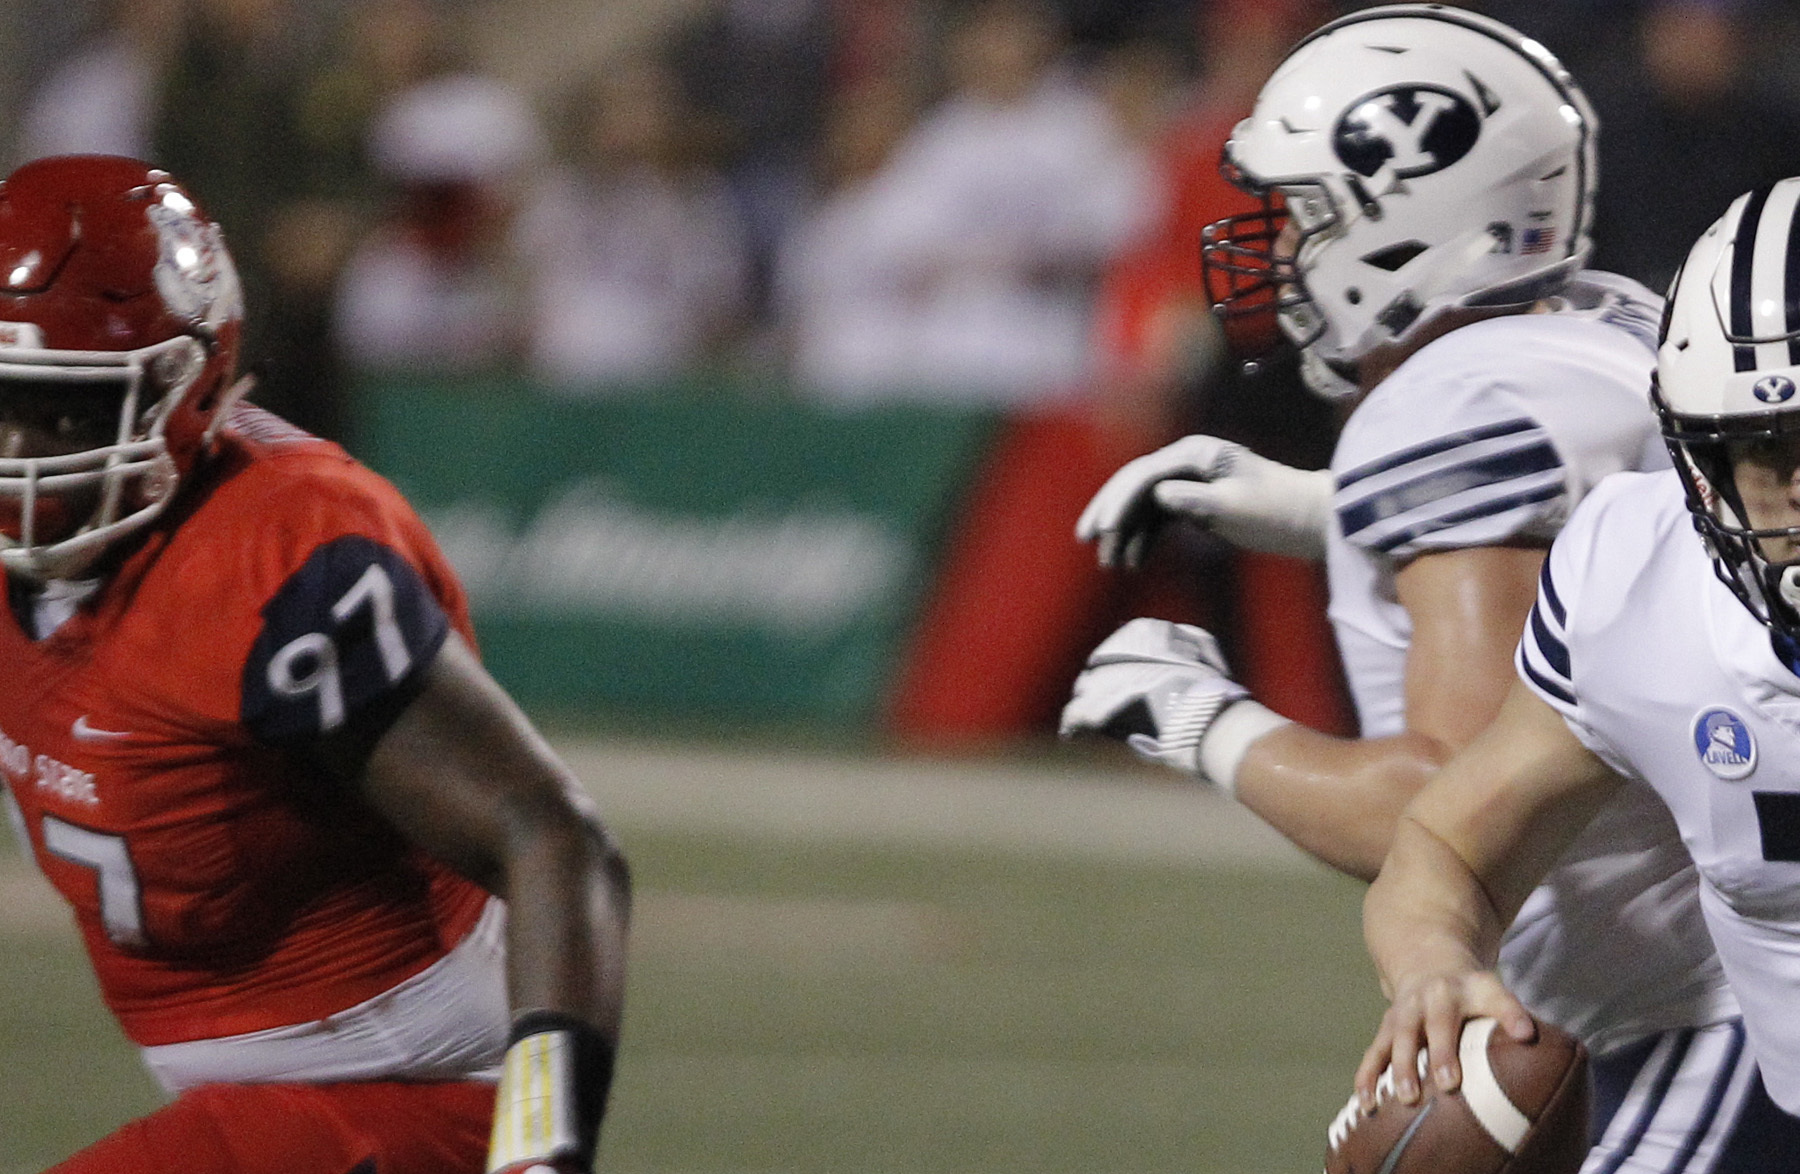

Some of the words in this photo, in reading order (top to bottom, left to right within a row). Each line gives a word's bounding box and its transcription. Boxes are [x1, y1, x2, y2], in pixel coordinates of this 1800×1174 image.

[1347, 90, 1456, 170] Y
[1757, 378, 1789, 402] Y
[267, 562, 412, 732] 97
[41, 811, 150, 946] 7
